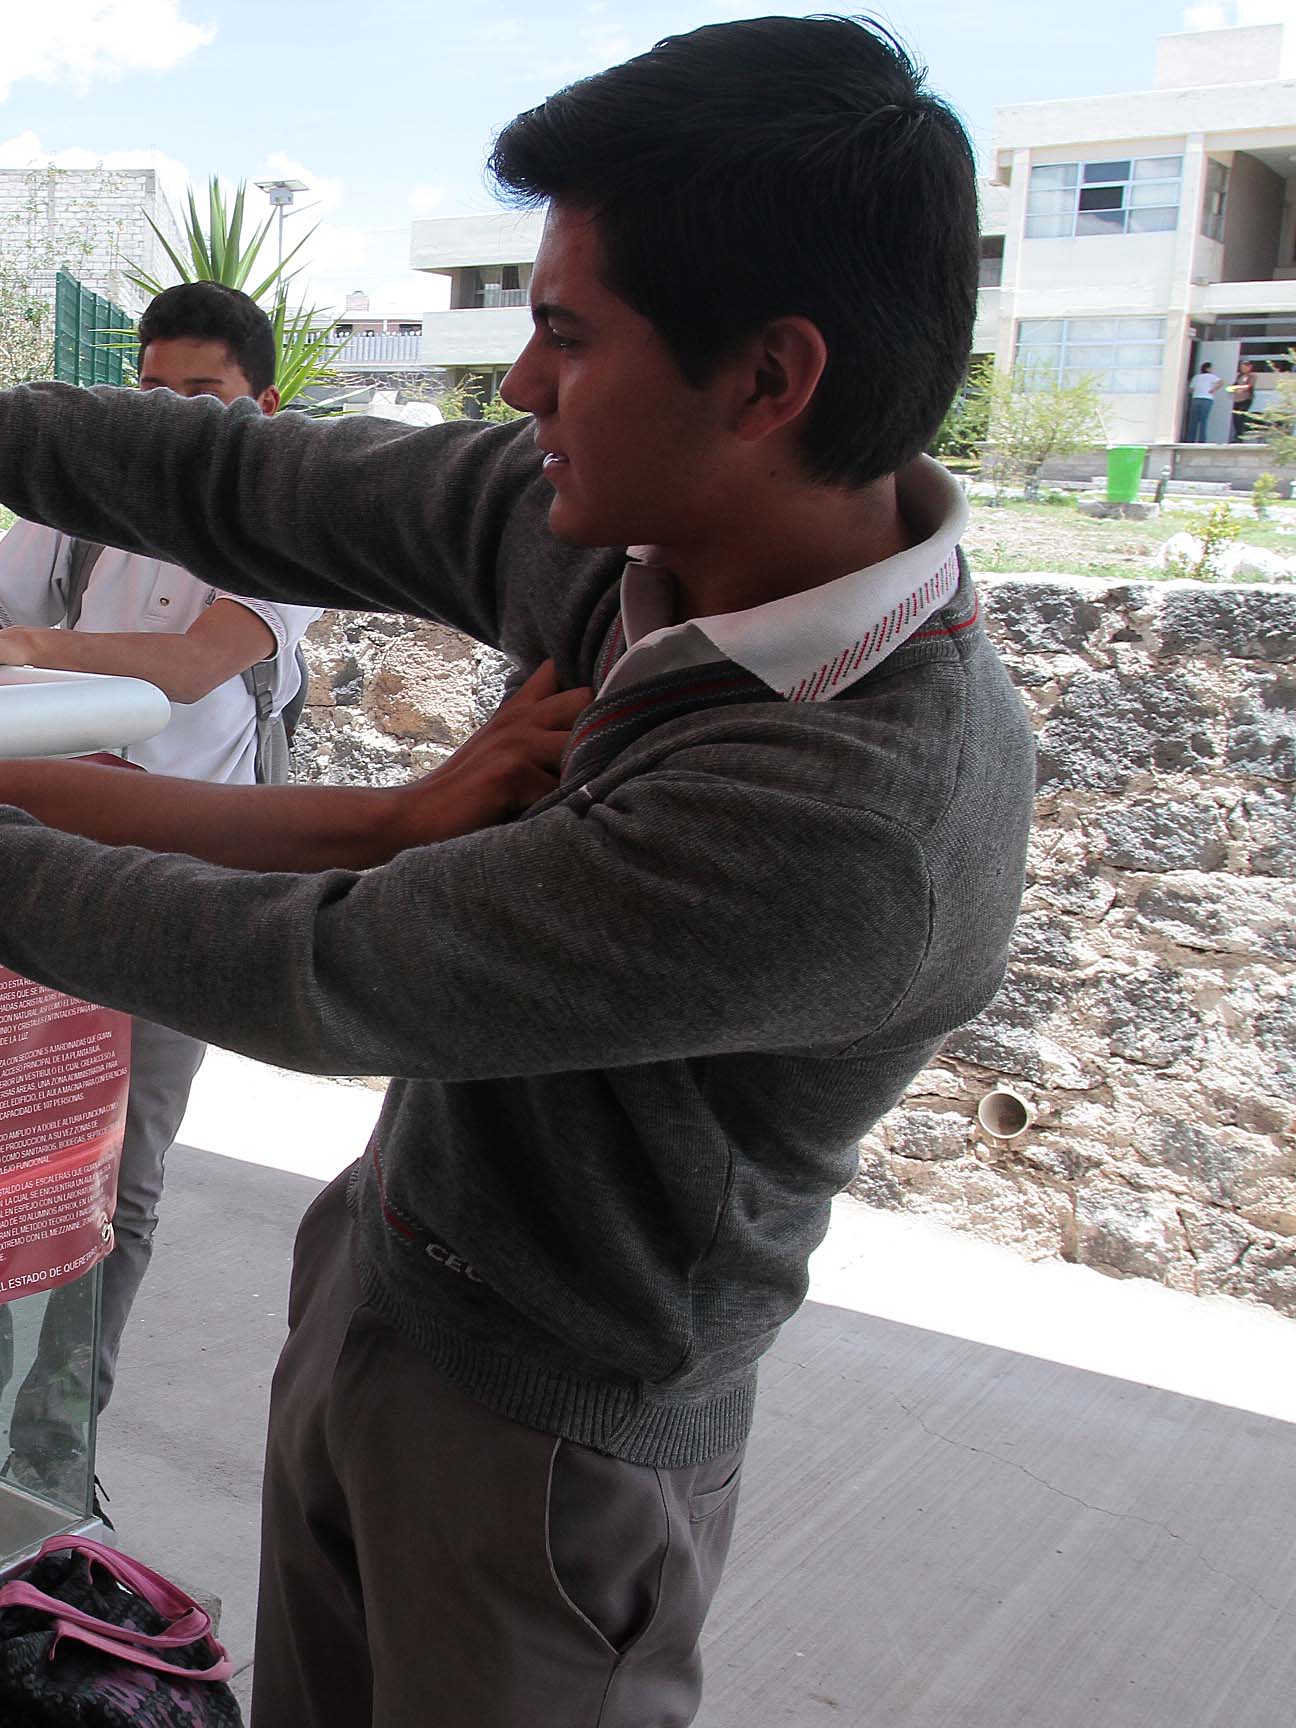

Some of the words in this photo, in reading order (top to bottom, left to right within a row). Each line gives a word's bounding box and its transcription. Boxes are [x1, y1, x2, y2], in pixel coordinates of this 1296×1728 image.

[16, 988, 29, 997] QUE
[0, 1036, 8, 1045] DE
[9, 1034, 16, 1042] LA
[6, 1055, 18, 1065] CON
[86, 1034, 96, 1044] QUE
[52, 1054, 60, 1063] DE
[61, 1052, 69, 1060] LA
[57, 1064, 64, 1072] EL
[37, 1078, 50, 1088] UNA
[0, 1099, 10, 1109] DEL
[38, 1090, 46, 1099] EL
[32, 1102, 42, 1111] DE
[8, 1127, 31, 1139] AMPLIO
[52, 1130, 61, 1139] SU
[91, 1119, 98, 1128] DE
[1, 1151, 20, 1163] COMO
[21, 1180, 33, 1190] LAS
[35, 1170, 71, 1186] ESCALERAS
[71, 1167, 83, 1176] QUE
[4, 1196, 13, 1205] LA
[13, 1192, 29, 1203] CUAL
[29, 1190, 38, 1198] SE
[4, 1207, 13, 1216] EN
[14, 1201, 38, 1214] ESPEJO
[38, 1197, 52, 1207] CON
[53, 1194, 62, 1203] UN
[9, 1216, 18, 1225] DE
[18, 1214, 26, 1223] 50
[11, 1227, 19, 1236] EL
[20, 1219, 47, 1233] METODO
[25, 1232, 40, 1242] CON
[40, 1230, 48, 1238] EL
[7, 1269, 47, 1290] ESTADO
[49, 1265, 62, 1278] DE
